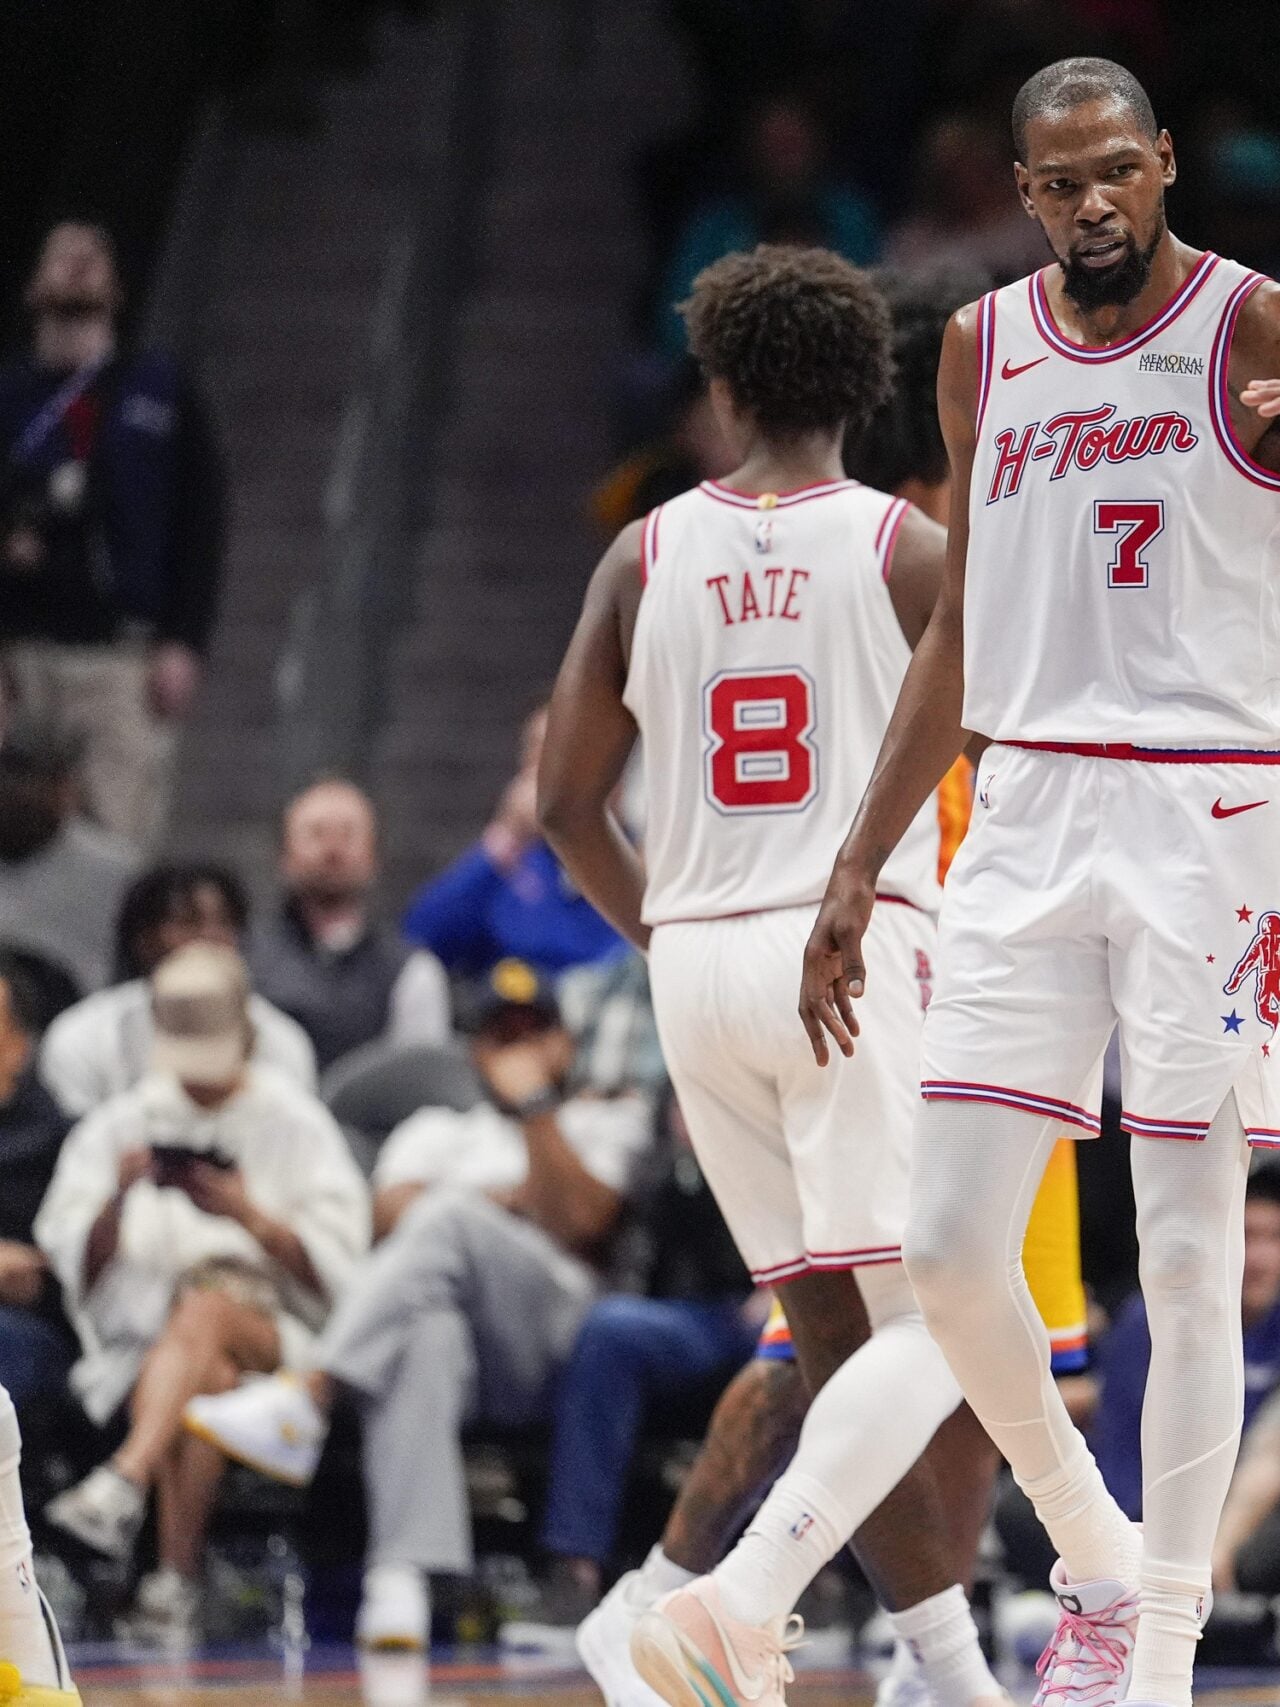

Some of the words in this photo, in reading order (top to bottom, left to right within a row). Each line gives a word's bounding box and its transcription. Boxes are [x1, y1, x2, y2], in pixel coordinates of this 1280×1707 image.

[1138, 360, 1204, 375] HERMANN
[1140, 353, 1205, 368] MEMORIAL
[986, 403, 1198, 505] H-Town
[1094, 500, 1164, 588] 7
[706, 568, 810, 626] TATE
[703, 664, 820, 817] 8
